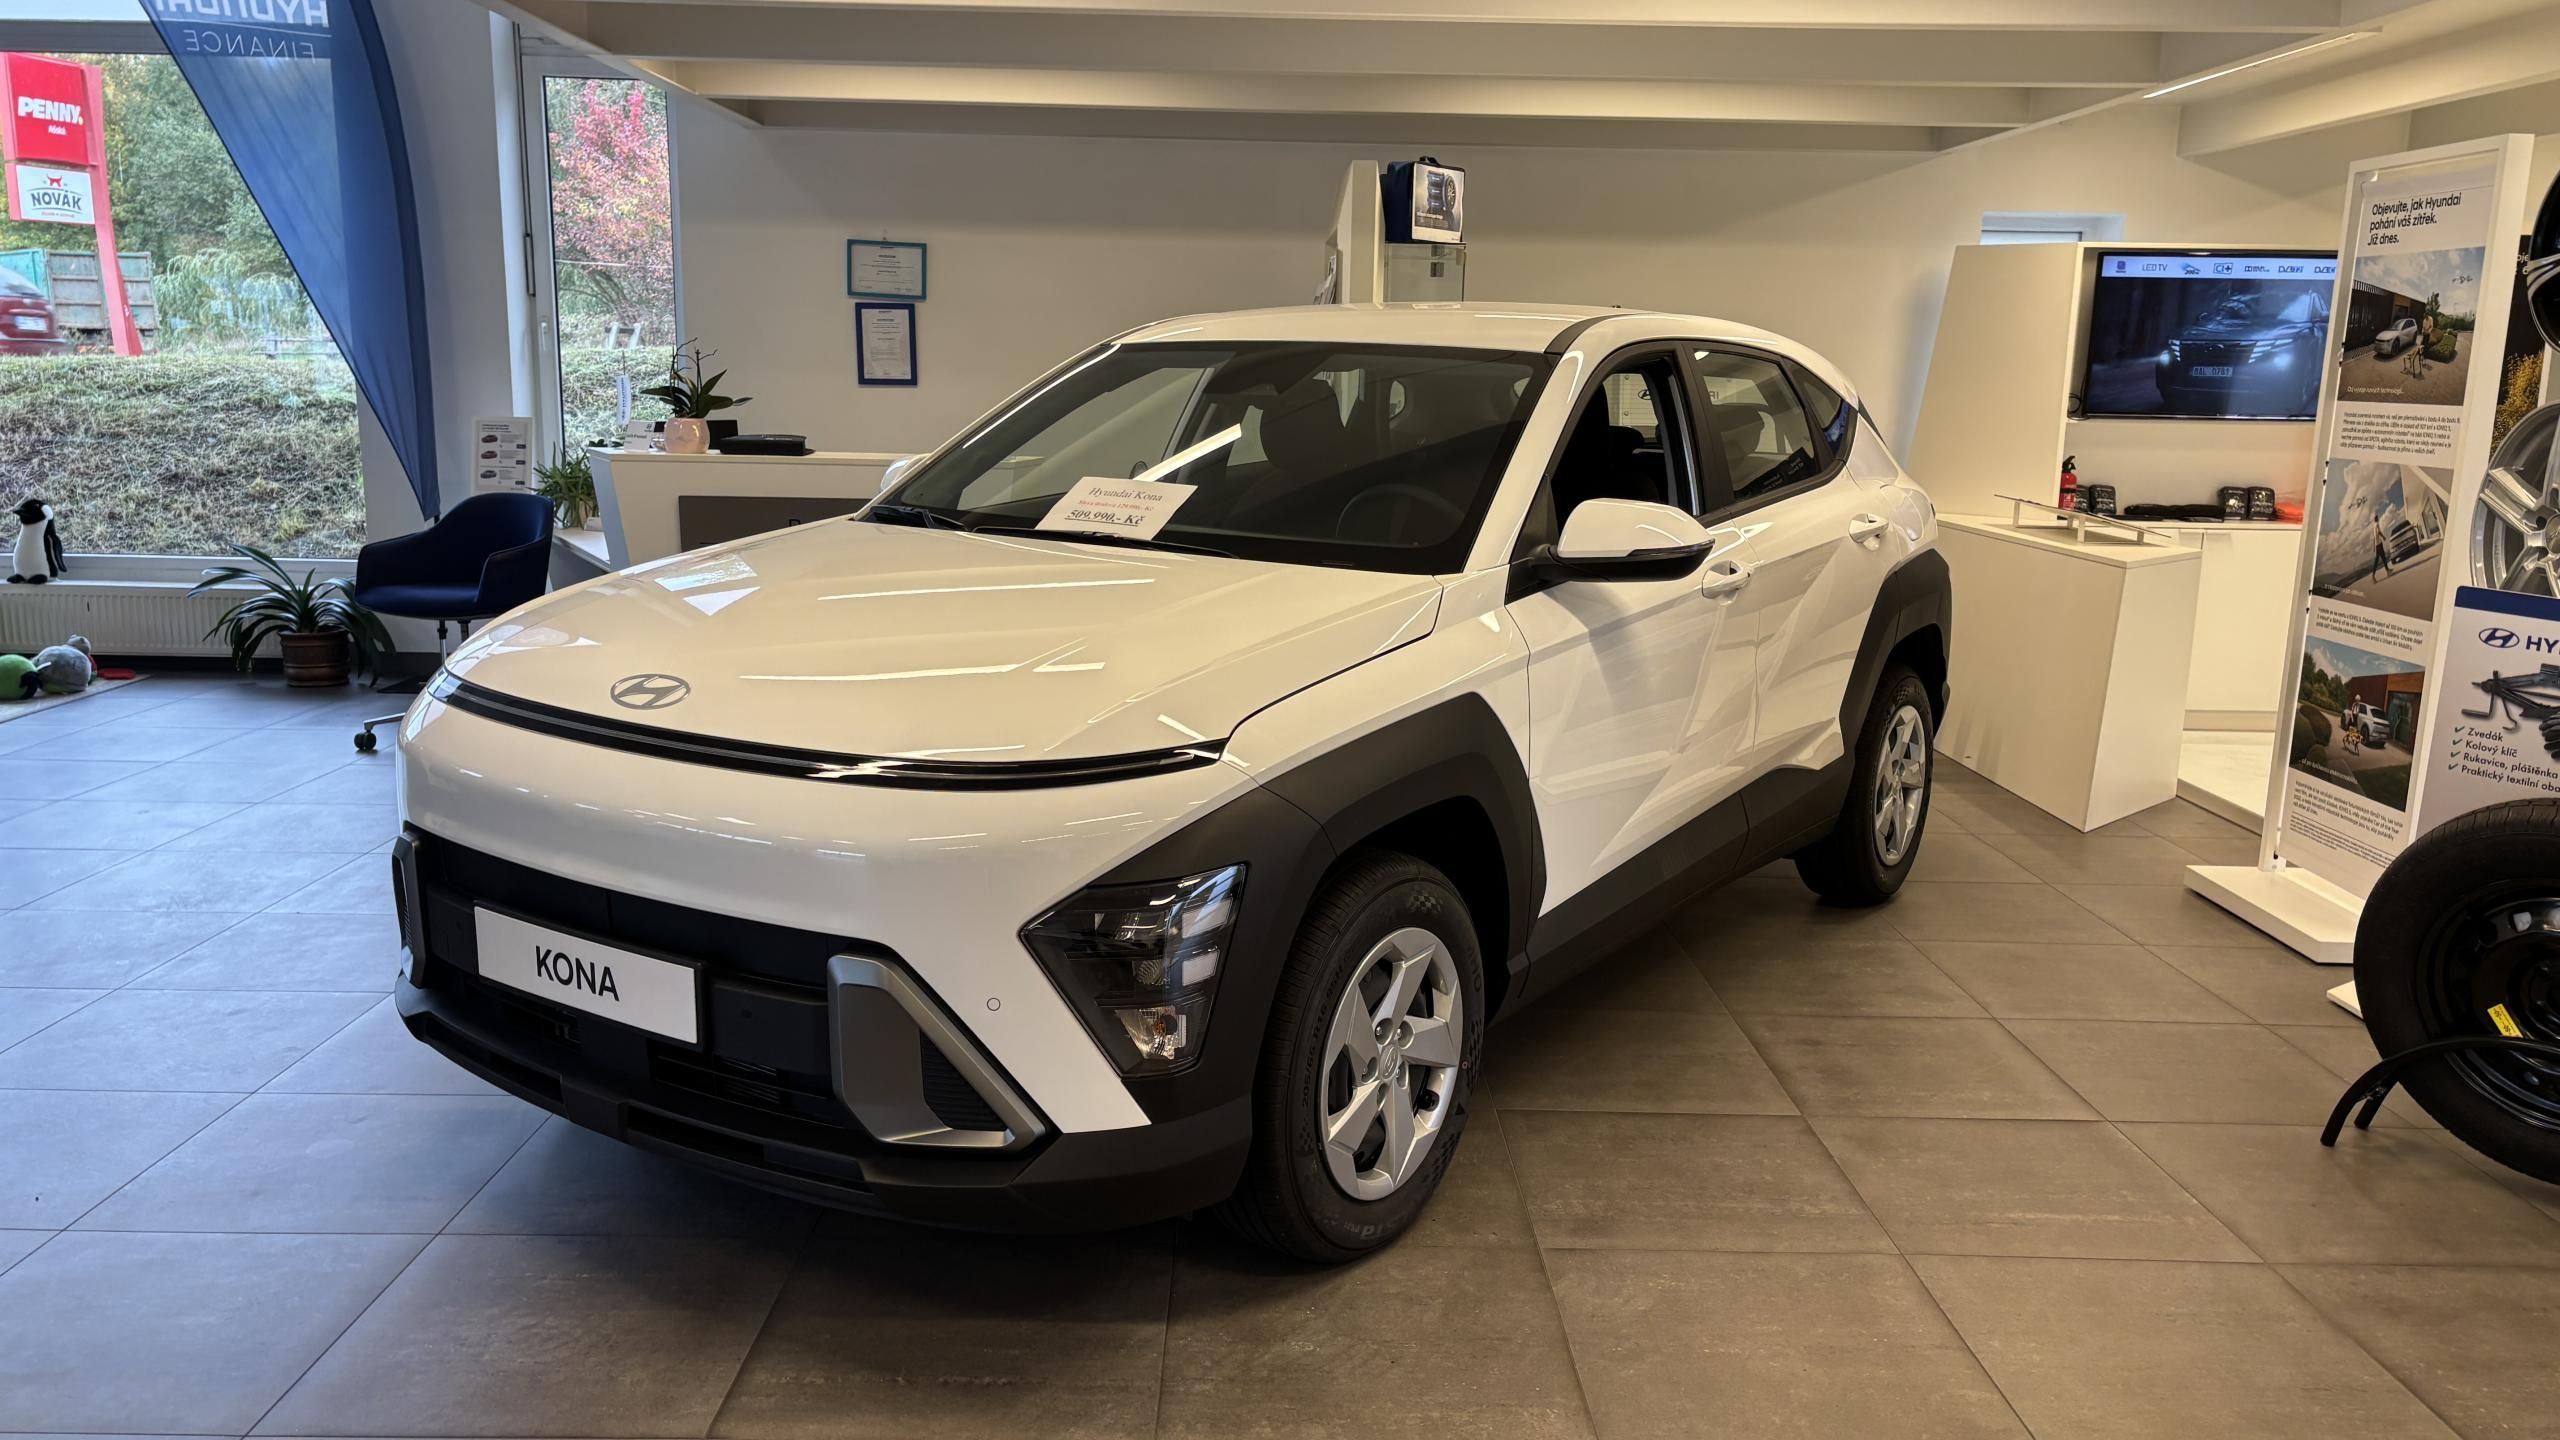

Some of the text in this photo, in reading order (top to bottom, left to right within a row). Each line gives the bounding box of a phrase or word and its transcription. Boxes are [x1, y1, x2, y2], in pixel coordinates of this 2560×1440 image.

[30, 190, 82, 211] NOVÁK
[2372, 192, 2462, 216] Objevujte, jak Hyundai
[2369, 216, 2396, 233] pohání
[2397, 214, 2412, 228] váš
[2367, 232, 2400, 246] Již dnes.
[2142, 263, 2168, 272] LED TV
[1089, 487, 1163, 501] Hyundai Kona
[1124, 514, 1146, 525] Kč
[2525, 635, 2560, 655] HY
[2467, 727, 2503, 742] Zvedák
[2465, 739, 2518, 758] Kolový klíč
[2463, 752, 2558, 779] Rukavice, pláštěnka
[2461, 764, 2504, 783] Praktický
[2507, 775, 2540, 789] textilní
[535, 945, 620, 1002] KONA
